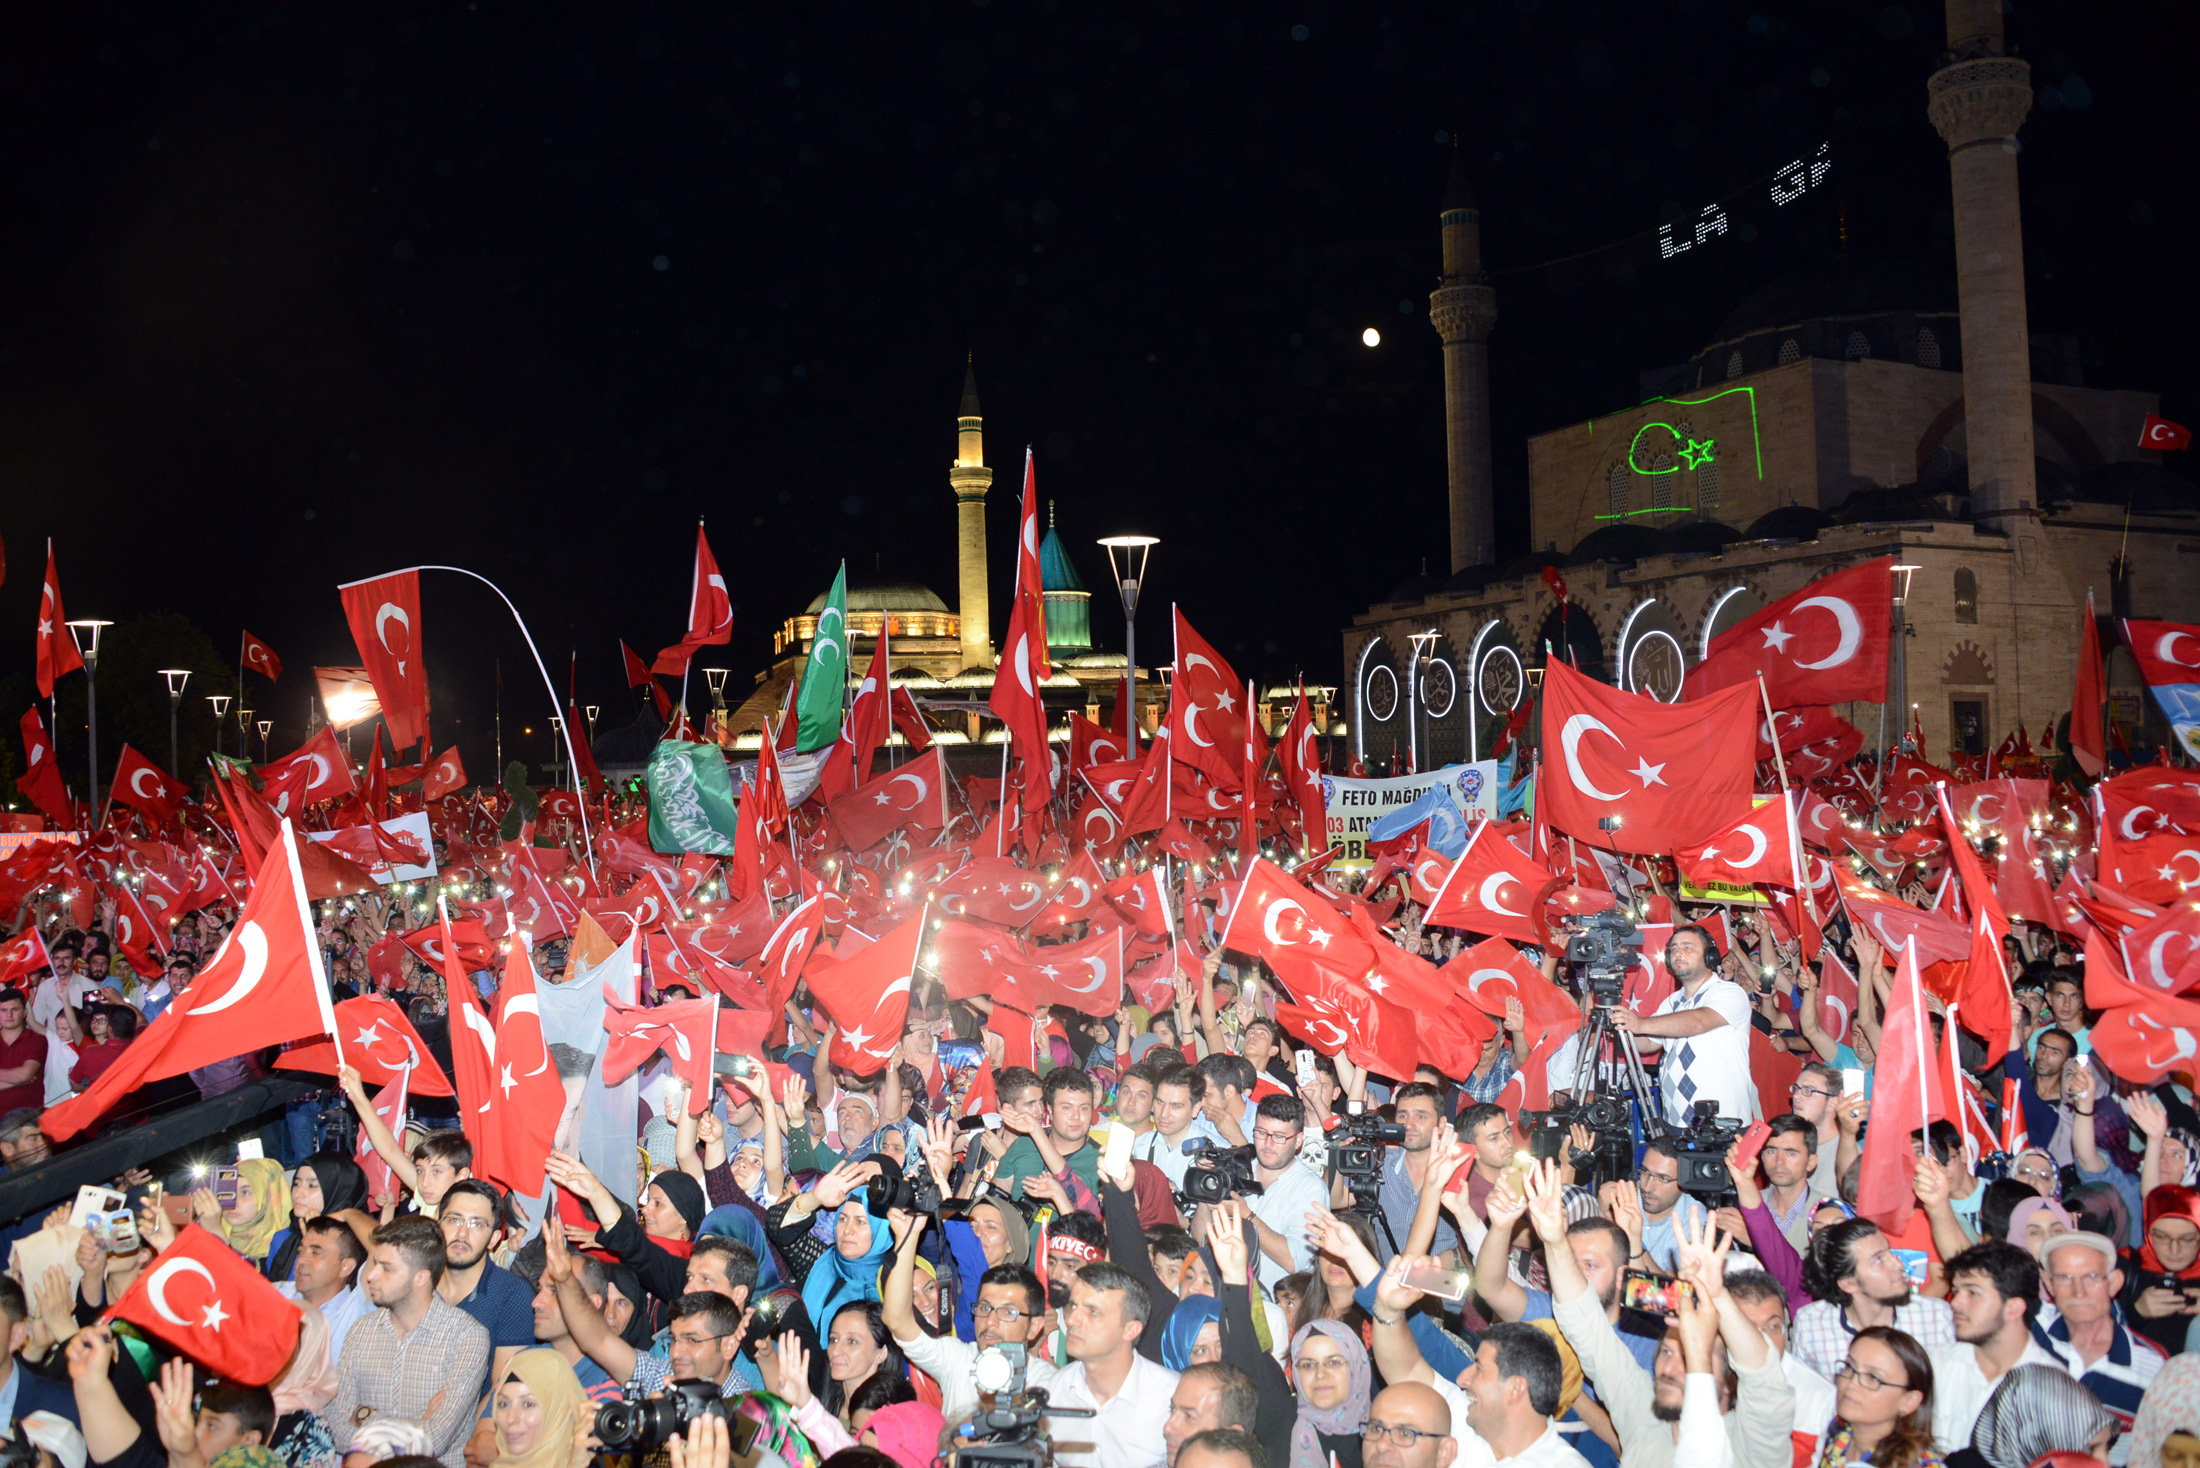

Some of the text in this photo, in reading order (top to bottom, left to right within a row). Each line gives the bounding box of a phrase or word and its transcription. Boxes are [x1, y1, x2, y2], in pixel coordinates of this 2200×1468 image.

[1342, 783, 1451, 806] FETO MAĞD
[1349, 816, 1382, 833] ATA
[1717, 882, 1728, 891] BU
[1051, 1236, 1085, 1256] KİYE
[940, 1287, 949, 1316] Canon
